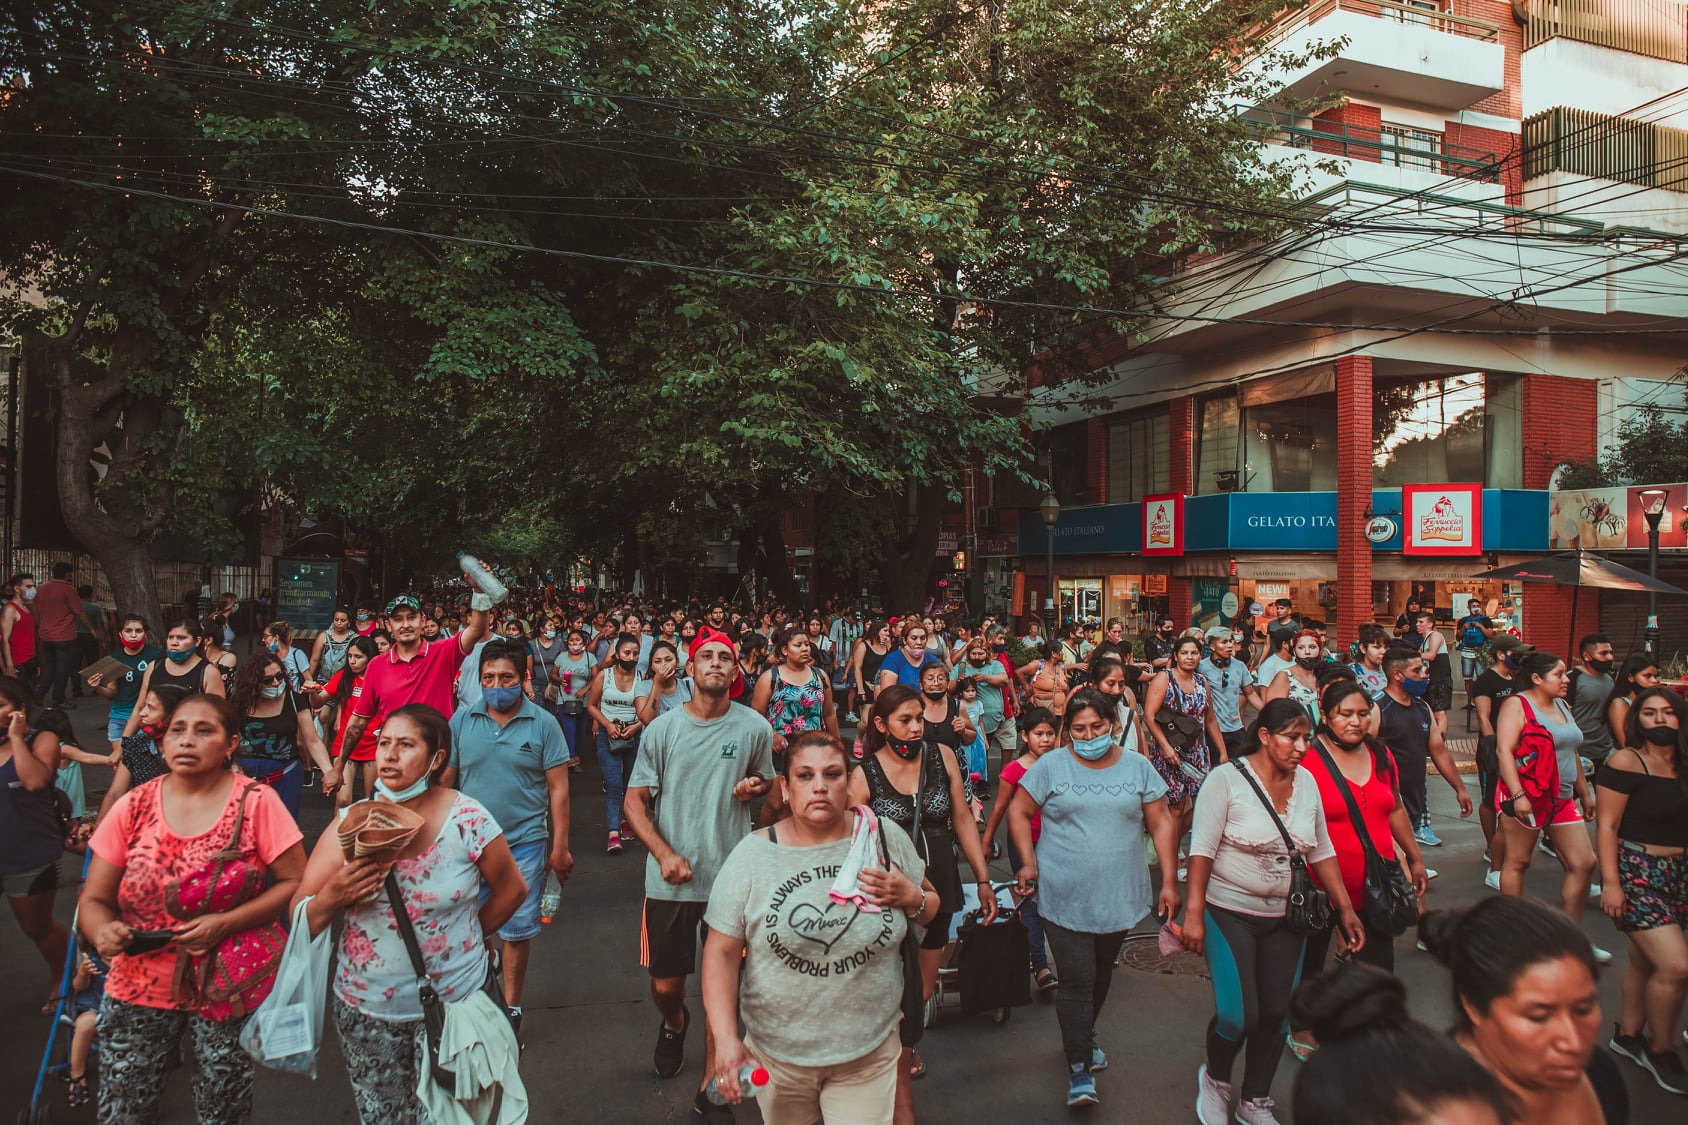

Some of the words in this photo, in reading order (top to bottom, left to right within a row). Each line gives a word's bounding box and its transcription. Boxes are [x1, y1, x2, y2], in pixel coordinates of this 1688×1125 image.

[1247, 516, 1306, 527] GELATO
[1311, 516, 1336, 527] ITA
[1054, 526, 1073, 537] ELATO
[1073, 525, 1105, 536] ITALIANO
[1257, 583, 1287, 594] NEW!
[812, 864, 842, 881] THE
[770, 870, 813, 912] ALWAYS
[765, 914, 779, 929] IS
[872, 924, 894, 949] ALL
[766, 932, 830, 977] PROBLEMS
[834, 947, 876, 975] YOUR
